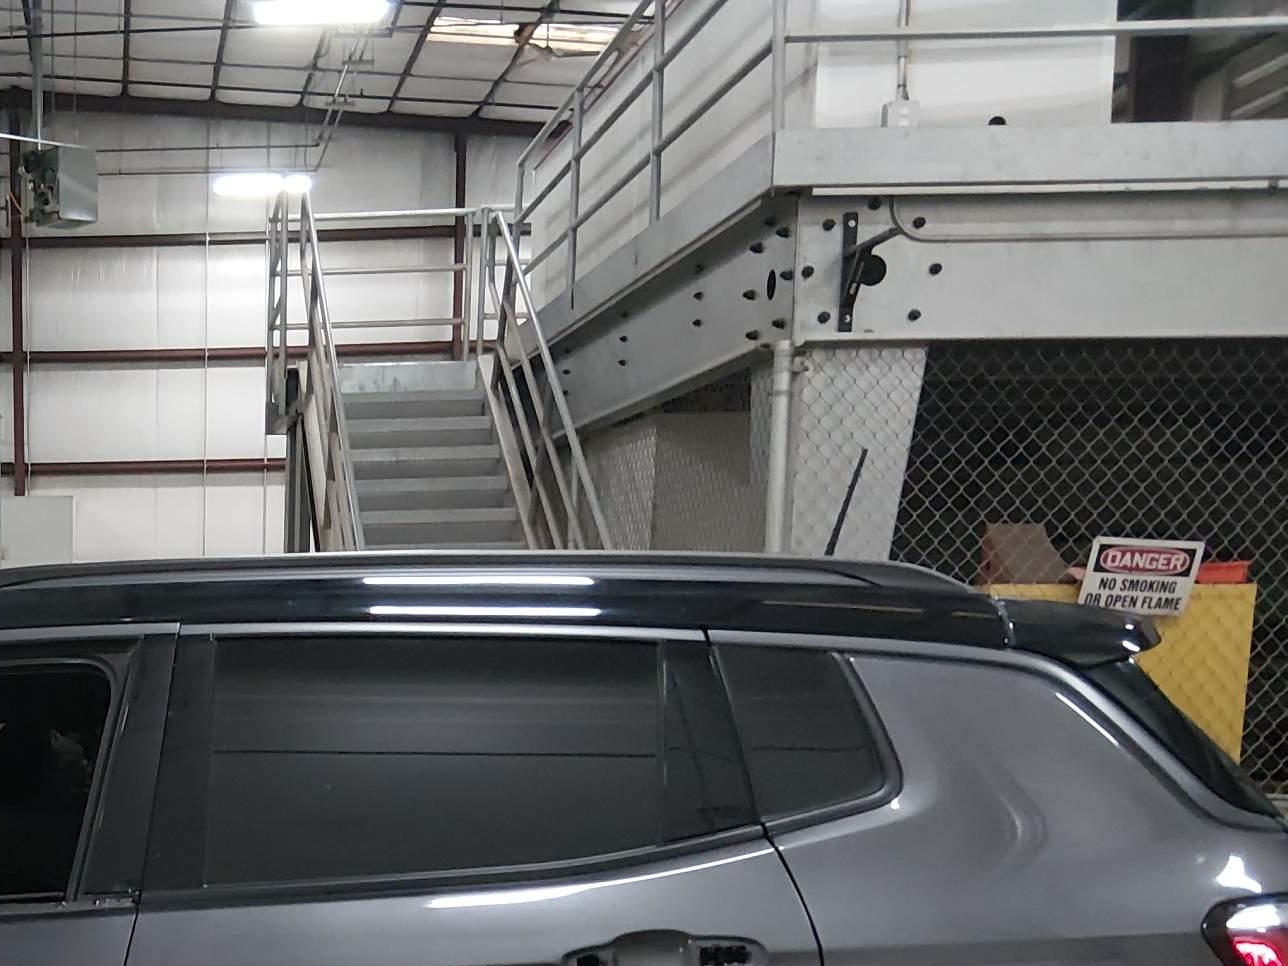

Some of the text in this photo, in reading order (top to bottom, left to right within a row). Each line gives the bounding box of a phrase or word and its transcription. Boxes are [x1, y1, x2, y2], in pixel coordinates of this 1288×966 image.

[1106, 550, 1185, 570] DANGER
[1098, 577, 1177, 594] NO SMOKING
[1104, 593, 1139, 609] OPEN
[1140, 595, 1183, 611] FLAME
